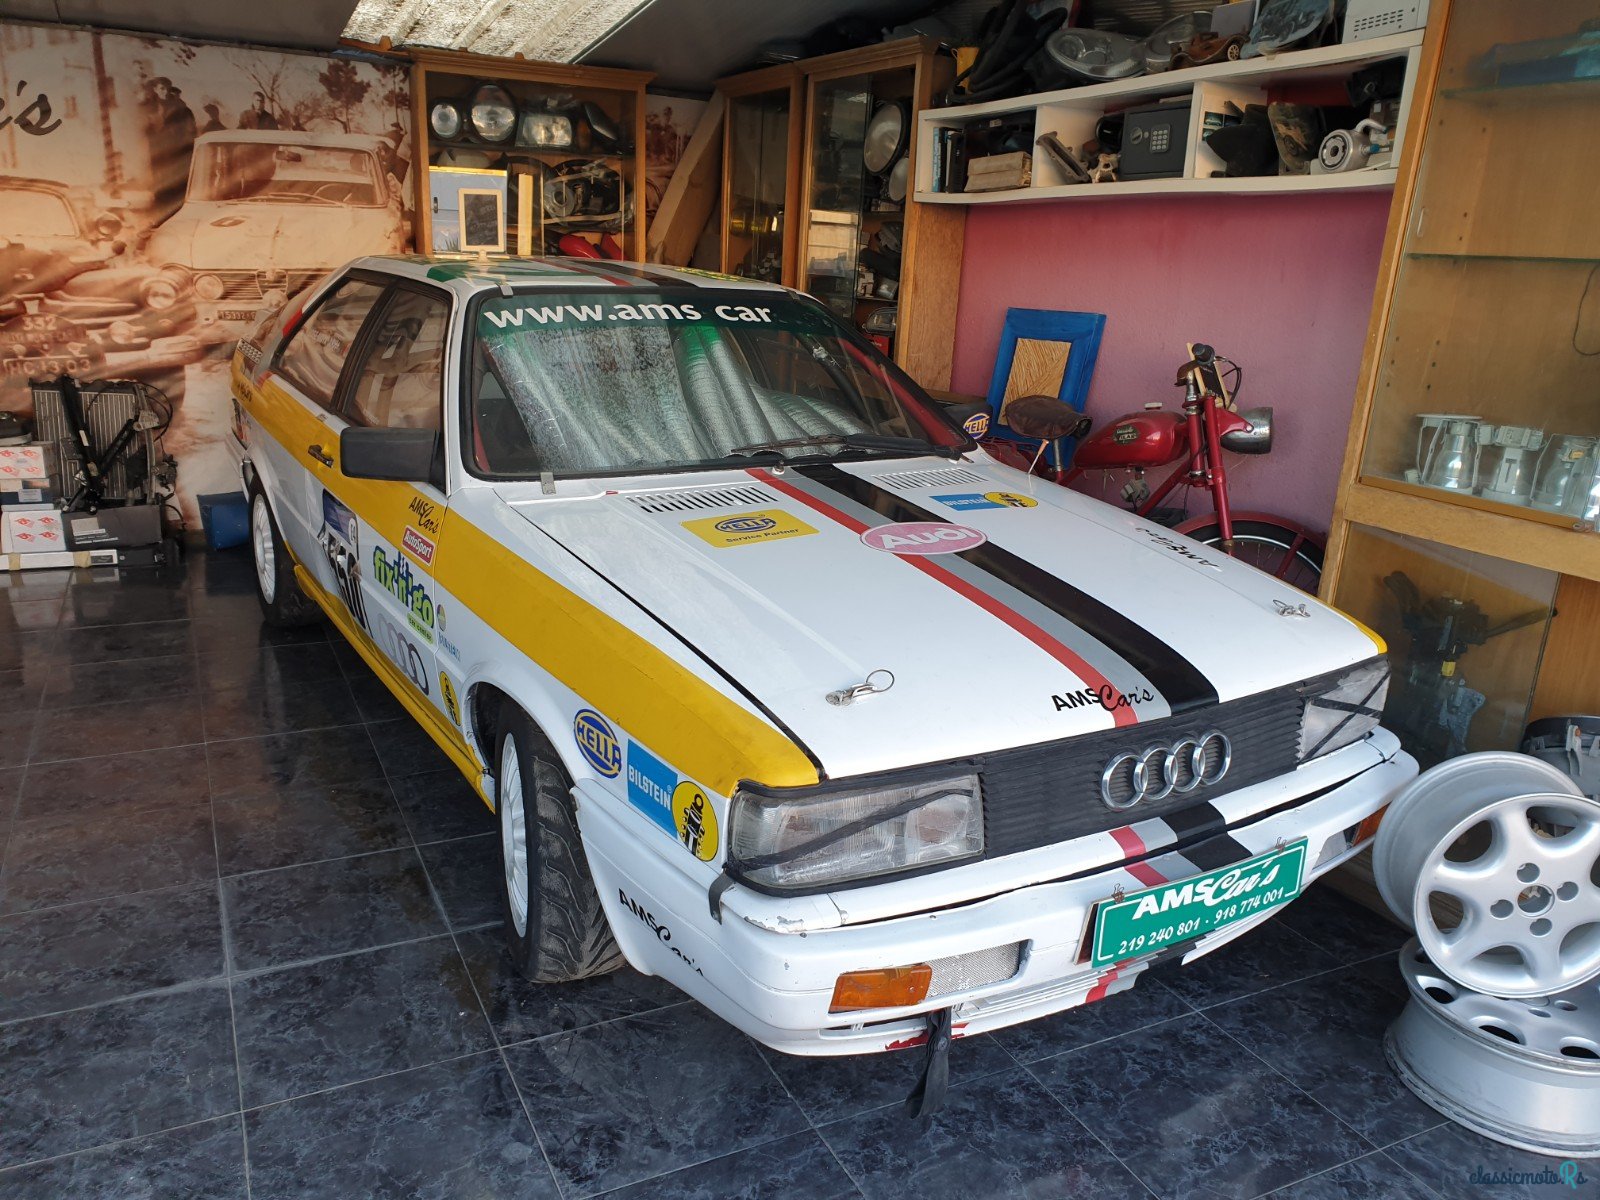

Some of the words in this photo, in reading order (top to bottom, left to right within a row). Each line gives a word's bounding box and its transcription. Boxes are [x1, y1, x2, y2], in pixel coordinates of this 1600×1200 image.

[715, 304, 772, 323] car
[719, 518, 776, 531] HELLA
[726, 533, 762, 543] Service
[764, 528, 800, 538] Partner
[879, 527, 979, 549] Audi
[576, 719, 622, 770] HELLA
[629, 765, 671, 811] BILSTEIN
[1118, 936, 1142, 955] 219
[1149, 926, 1174, 946] 240
[1176, 916, 1200, 936] 801
[1213, 905, 1236, 924] 918
[1240, 896, 1260, 914] 774
[1263, 886, 1284, 906] 001
